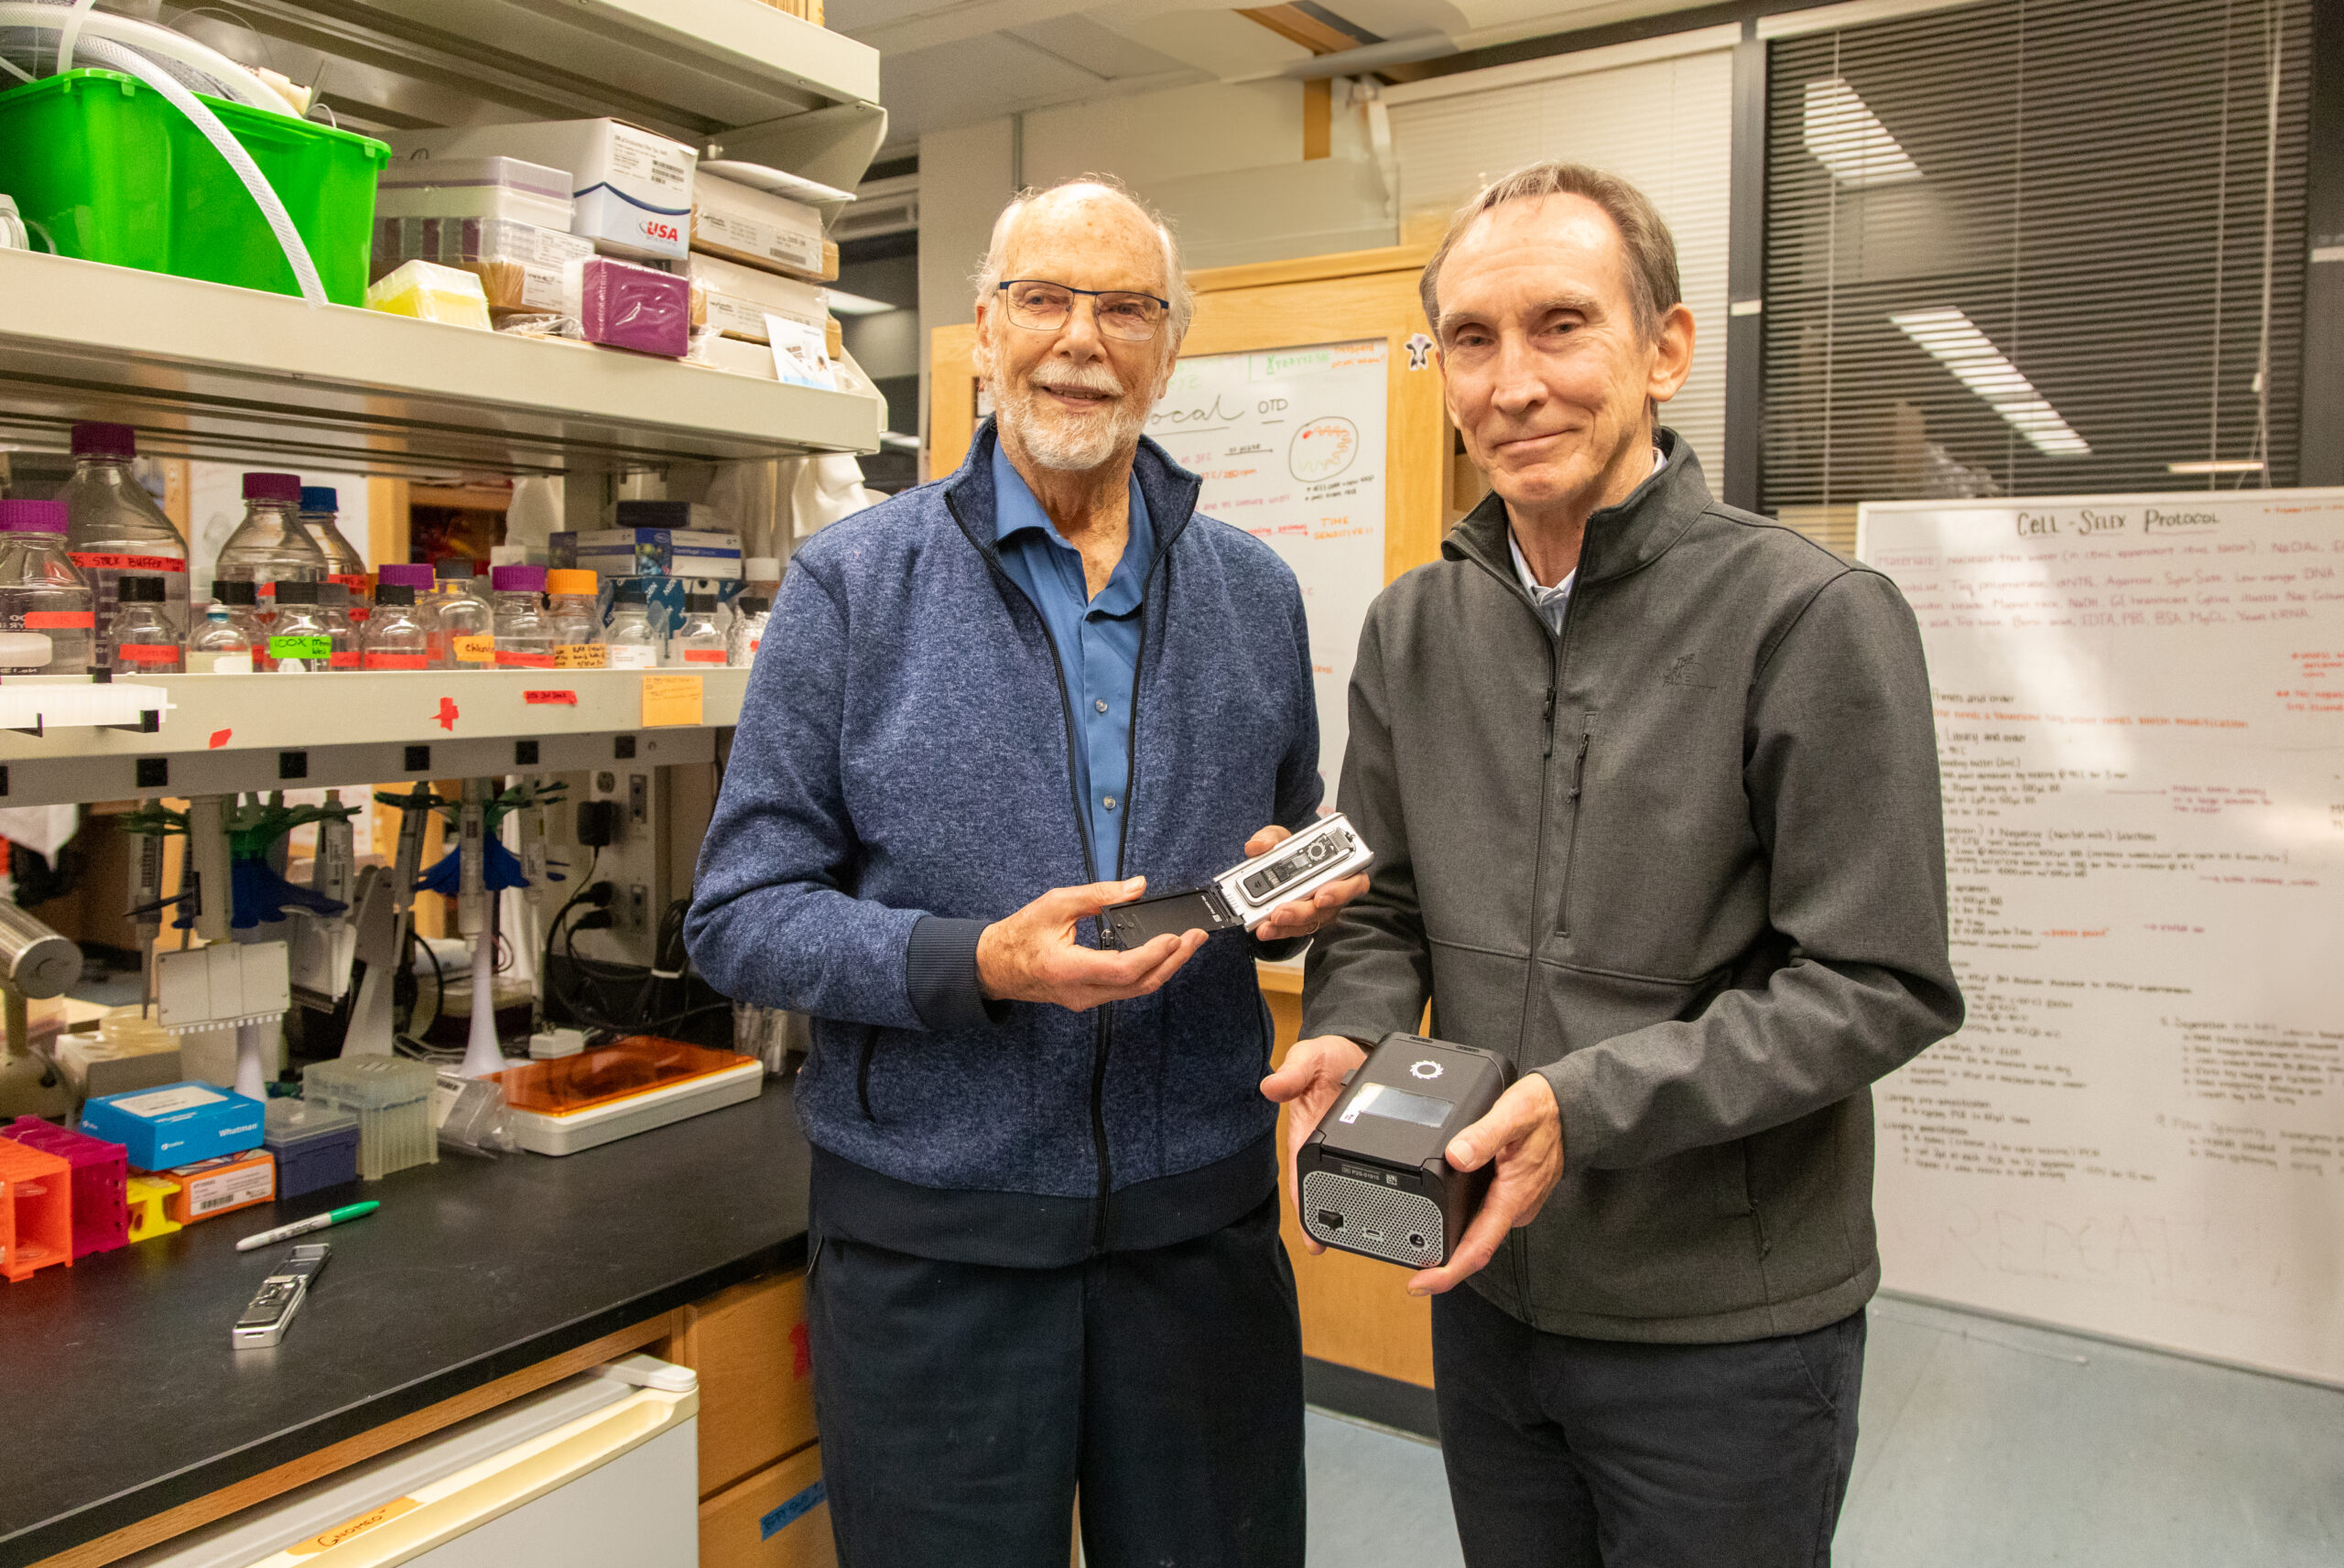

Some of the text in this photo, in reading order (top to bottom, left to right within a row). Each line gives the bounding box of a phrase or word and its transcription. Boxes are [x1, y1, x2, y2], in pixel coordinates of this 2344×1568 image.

[646, 221, 678, 243] USA
[1257, 397, 1289, 415] OTD
[1320, 515, 1349, 527] TIME
[218, 1122, 258, 1138] Whatman
